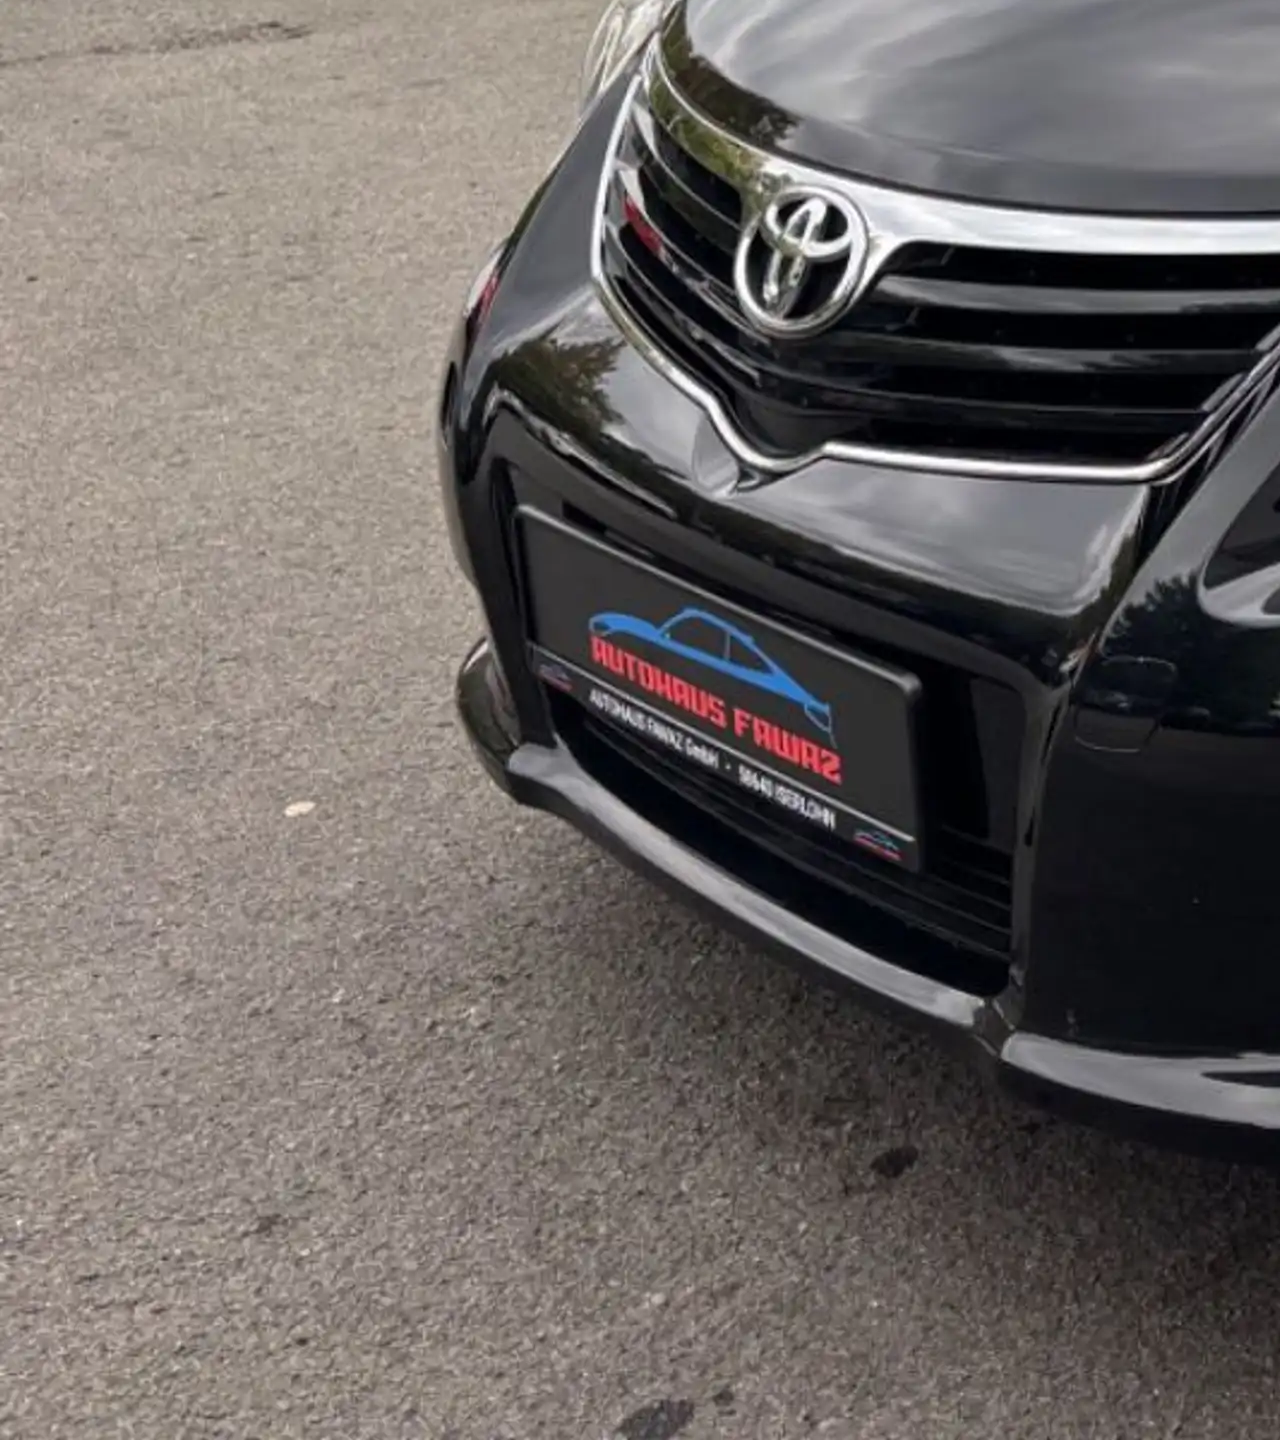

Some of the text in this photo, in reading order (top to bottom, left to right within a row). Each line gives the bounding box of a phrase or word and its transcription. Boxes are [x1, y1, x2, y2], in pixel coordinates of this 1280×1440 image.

[589, 688, 647, 731] AUTOHAUS
[685, 735, 720, 769] GmbH
[774, 788, 838, 832] ISERLOHN
[590, 635, 843, 786] AUTOHAUS FAWAZ
